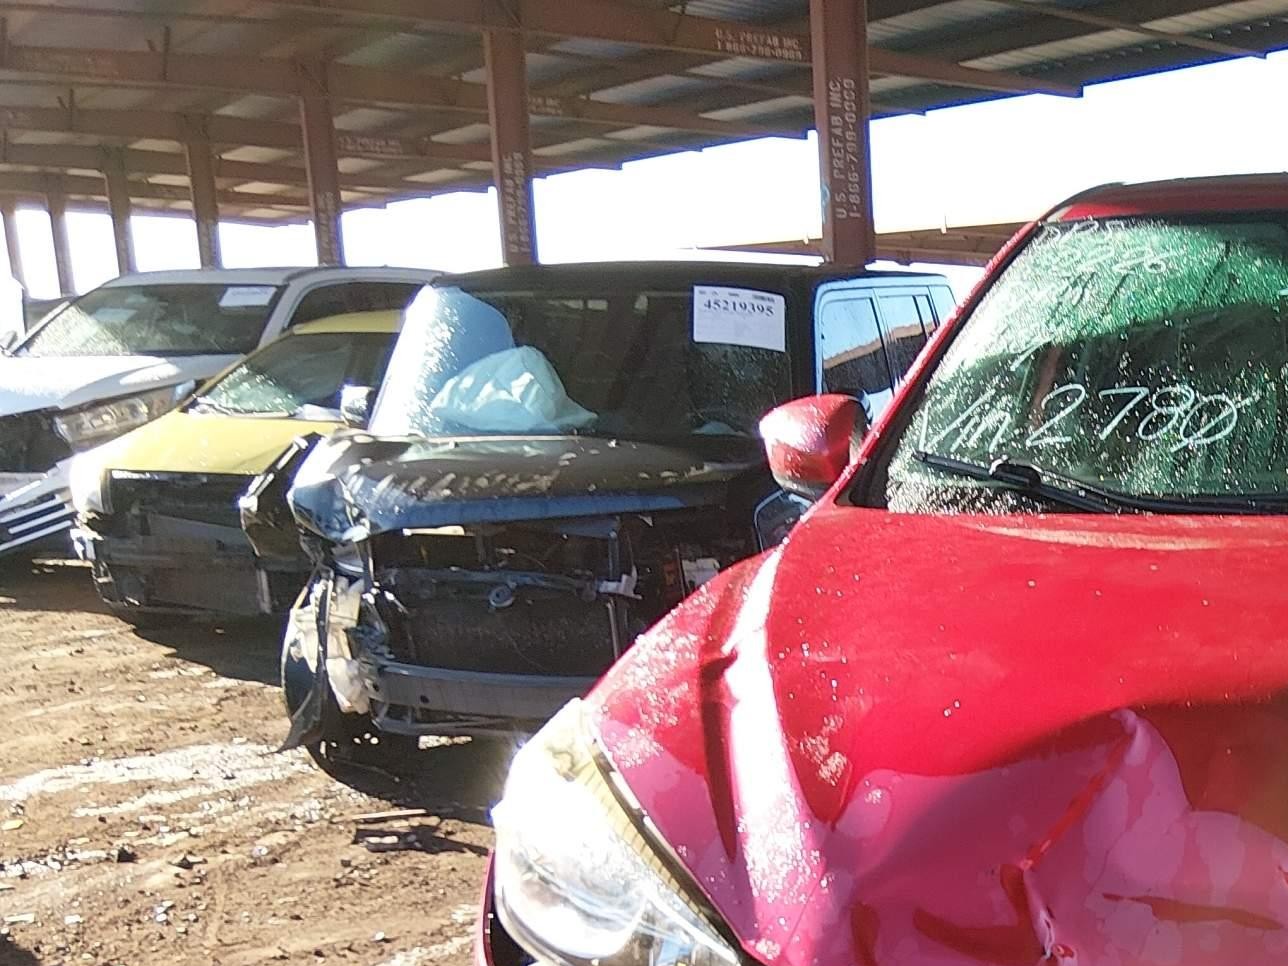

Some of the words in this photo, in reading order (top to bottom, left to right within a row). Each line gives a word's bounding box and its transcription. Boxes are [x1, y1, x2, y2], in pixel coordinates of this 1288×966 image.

[828, 76, 843, 109] INC.
[830, 115, 845, 180] PREFAB
[834, 188, 848, 219] U.S.
[703, 298, 775, 317] 45219395
[1025, 383, 1261, 454] 2780
